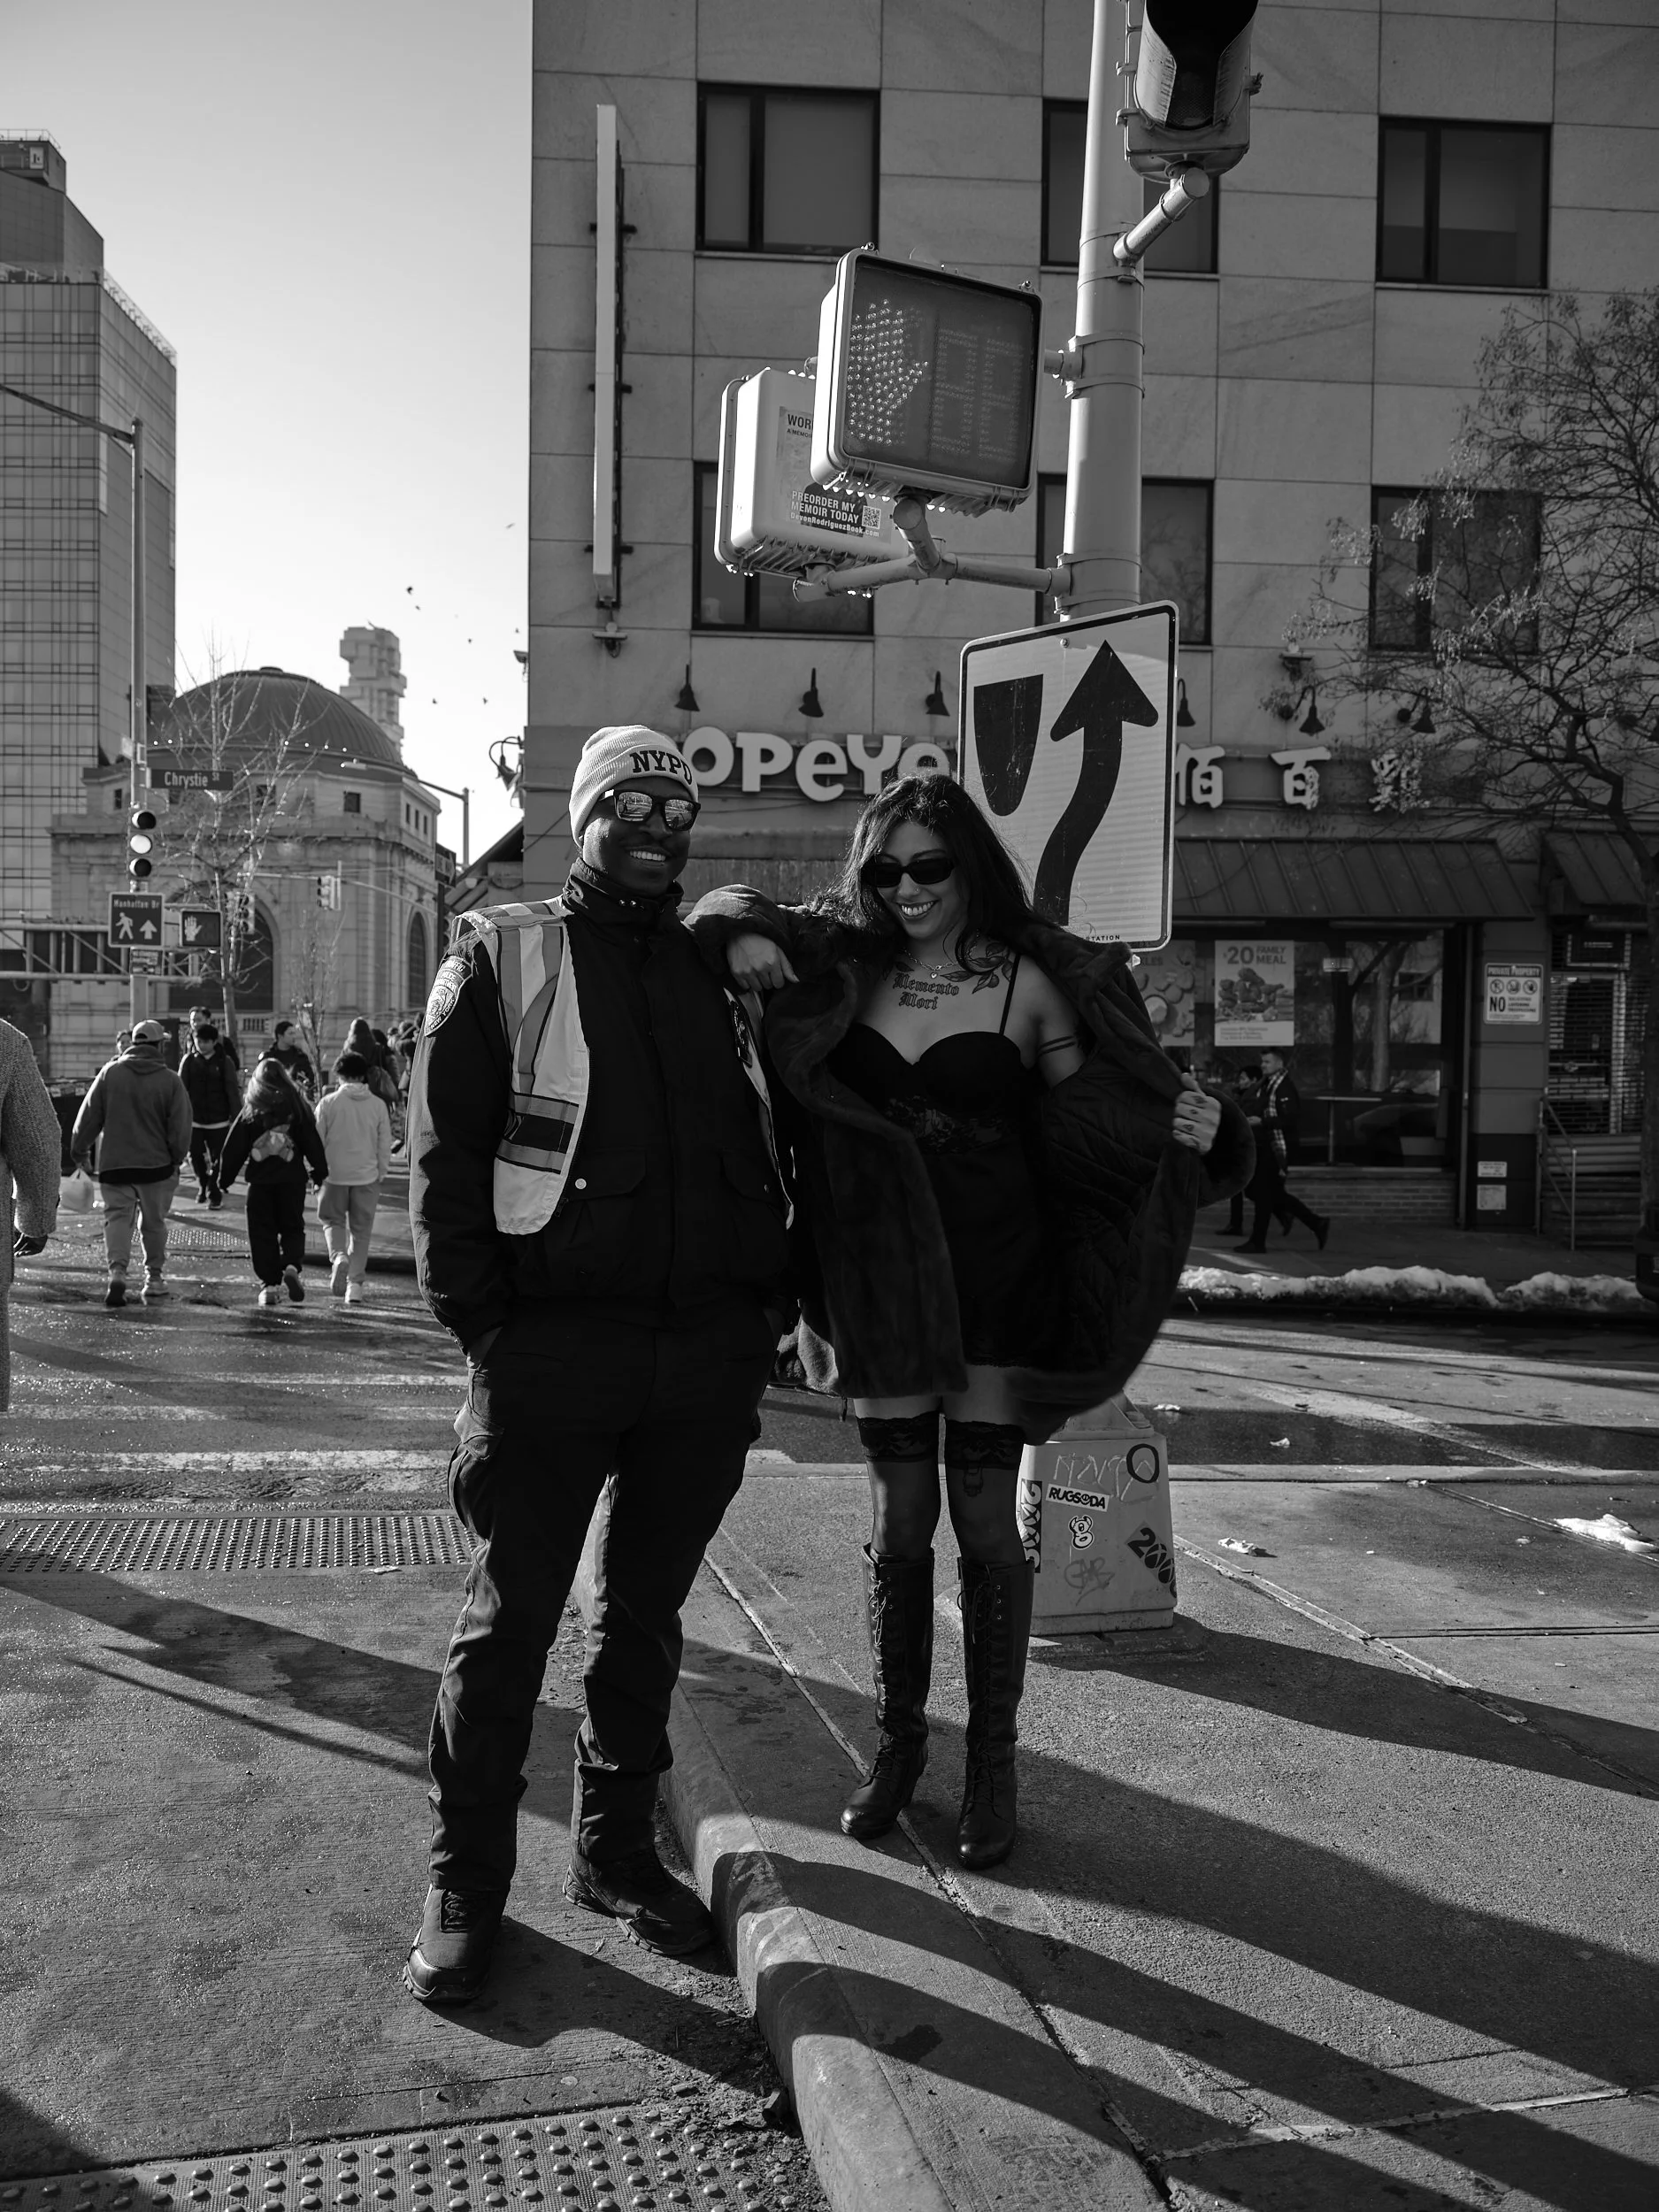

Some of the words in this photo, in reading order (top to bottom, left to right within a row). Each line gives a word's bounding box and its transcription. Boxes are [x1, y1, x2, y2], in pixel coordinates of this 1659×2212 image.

[787, 413, 813, 430] WOR
[792, 490, 839, 510] PREORDER
[841, 501, 856, 513] MY
[791, 501, 828, 517] MEMOIR
[830, 509, 859, 525] TODAY
[790, 511, 879, 537] DevonRodriguezBook.com
[629, 749, 693, 786] NYPD
[164, 771, 209, 789] Chrystie
[113, 898, 149, 909] Manhattan
[1257, 945, 1286, 954] FAMILY
[1257, 955, 1286, 964] MEAL
[892, 972, 960, 996] Memento
[898, 991, 939, 1010] Mori
[1489, 996, 1506, 1013] NO
